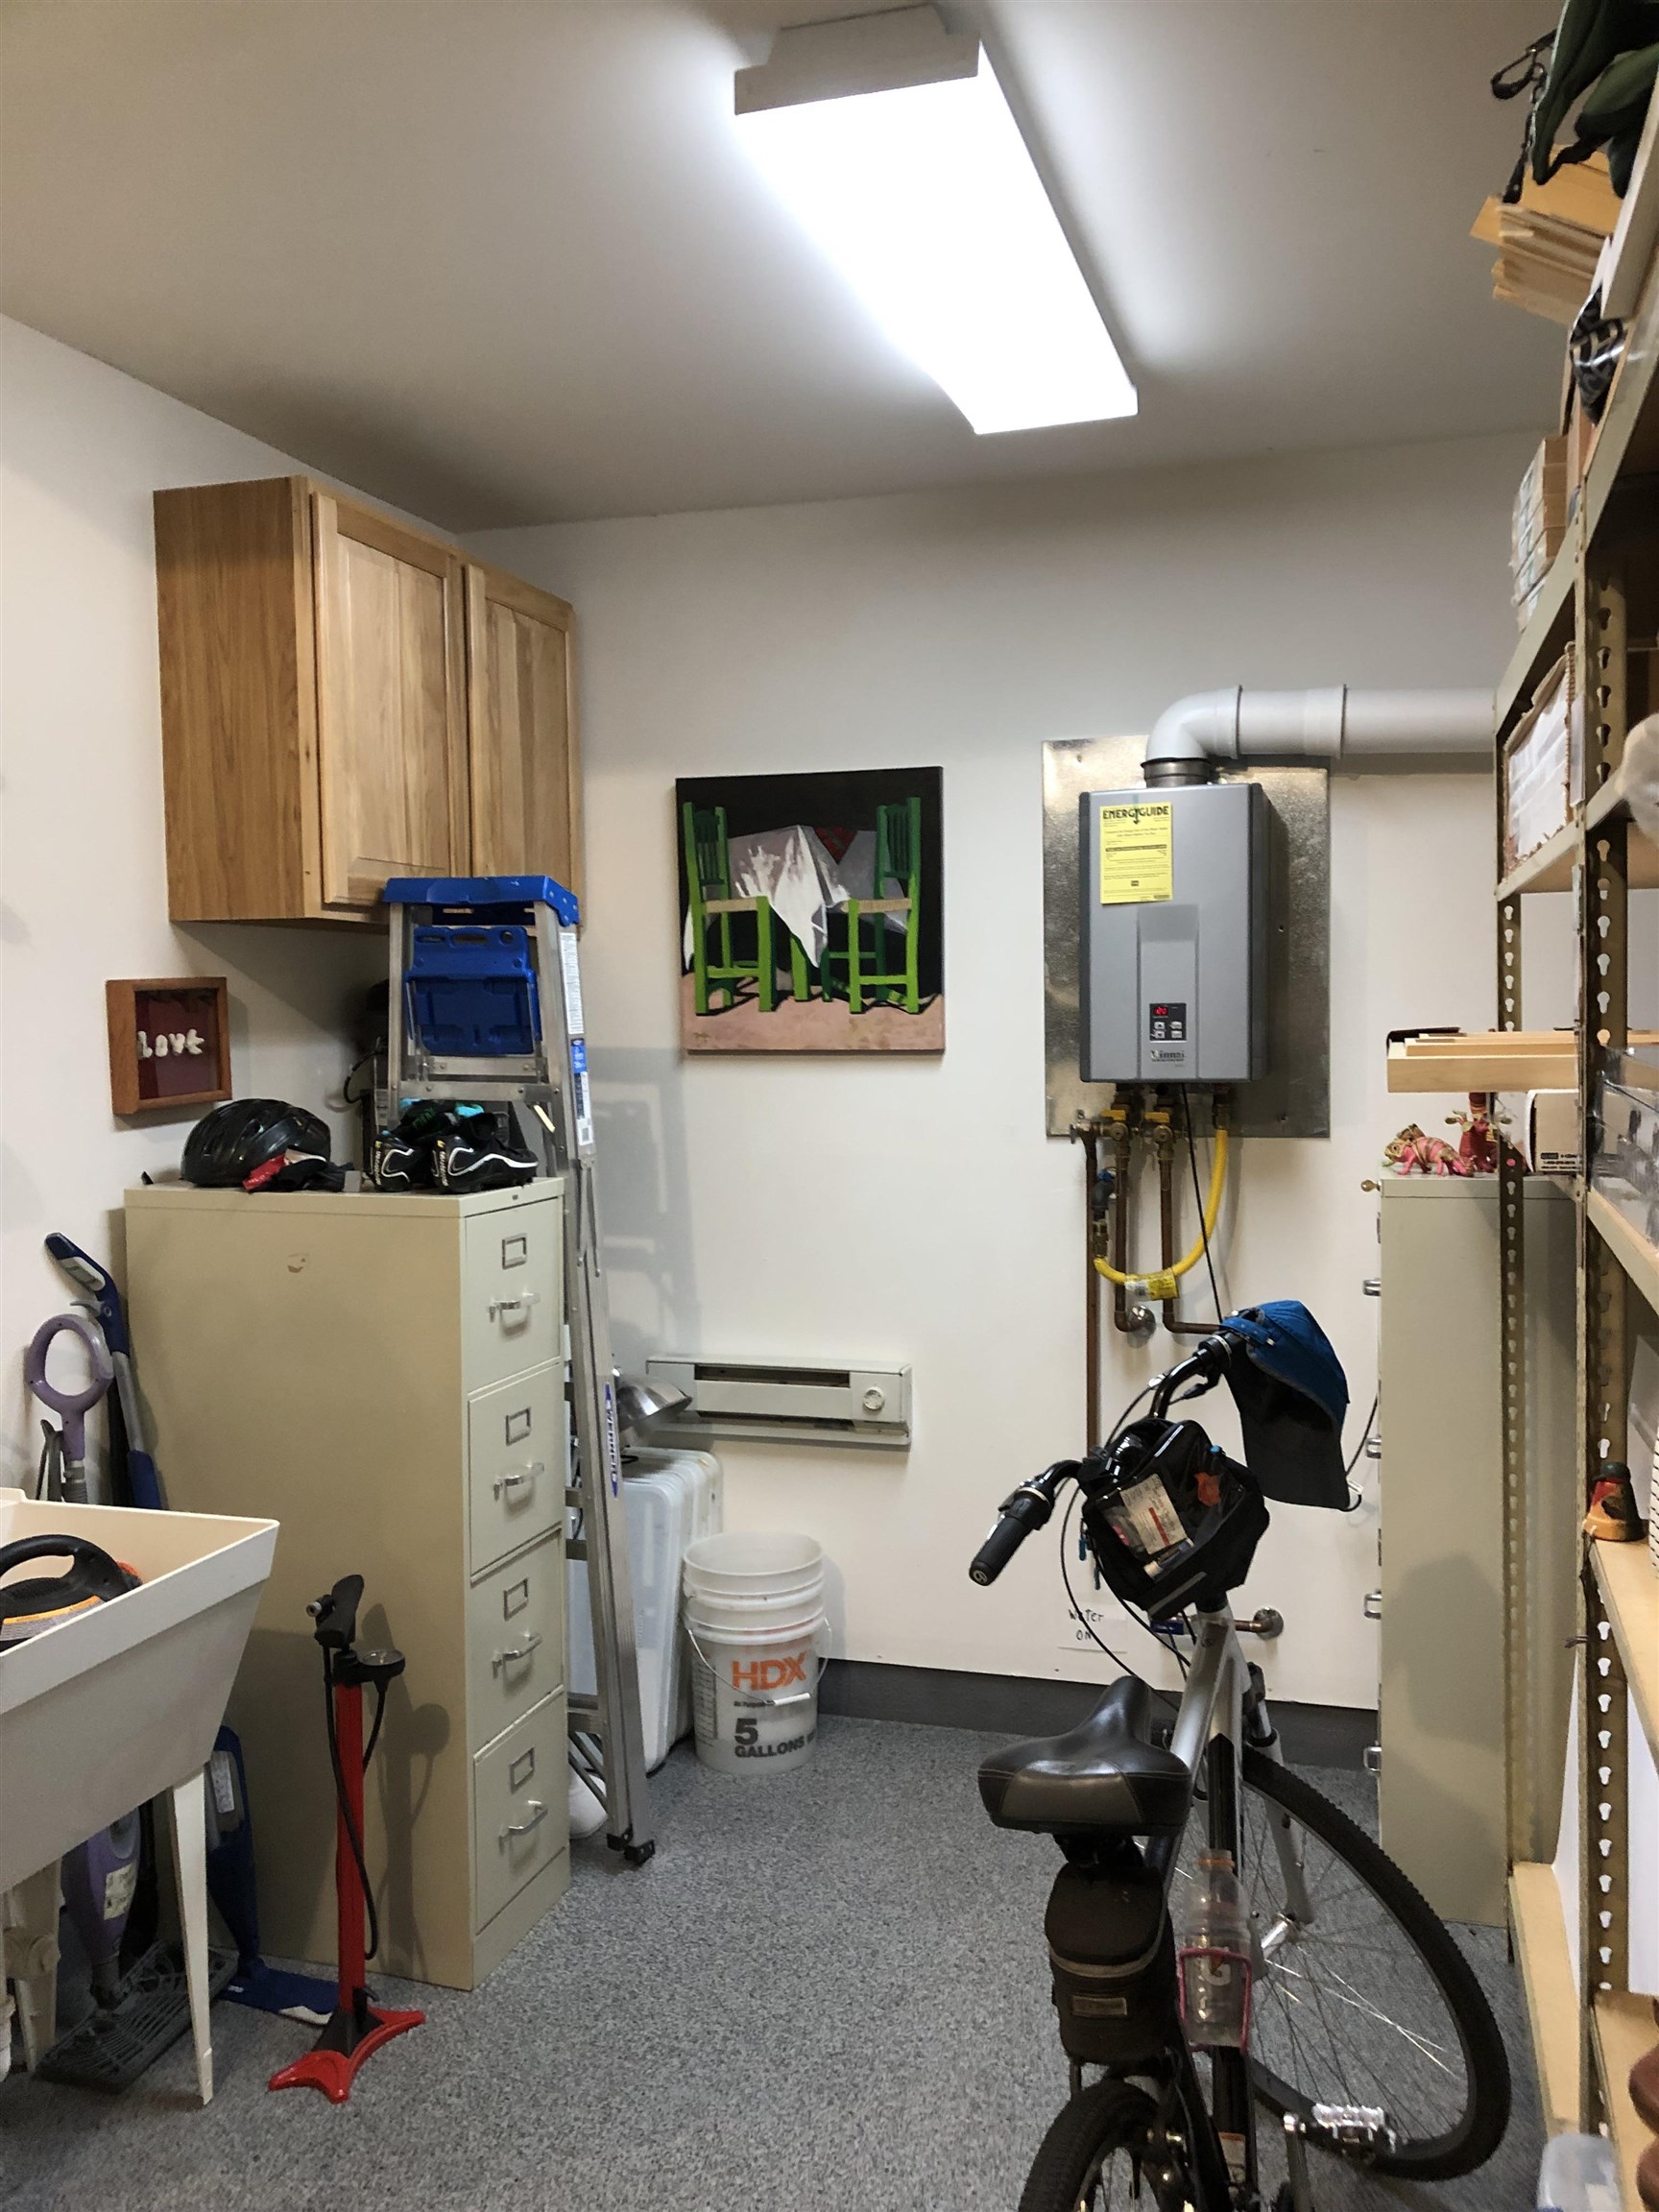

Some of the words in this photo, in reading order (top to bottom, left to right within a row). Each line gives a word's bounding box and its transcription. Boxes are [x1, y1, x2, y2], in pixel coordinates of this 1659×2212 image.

[732, 1651, 807, 1691] HDX
[733, 1718, 758, 1745] 5
[733, 1736, 805, 1758] GALLONS
